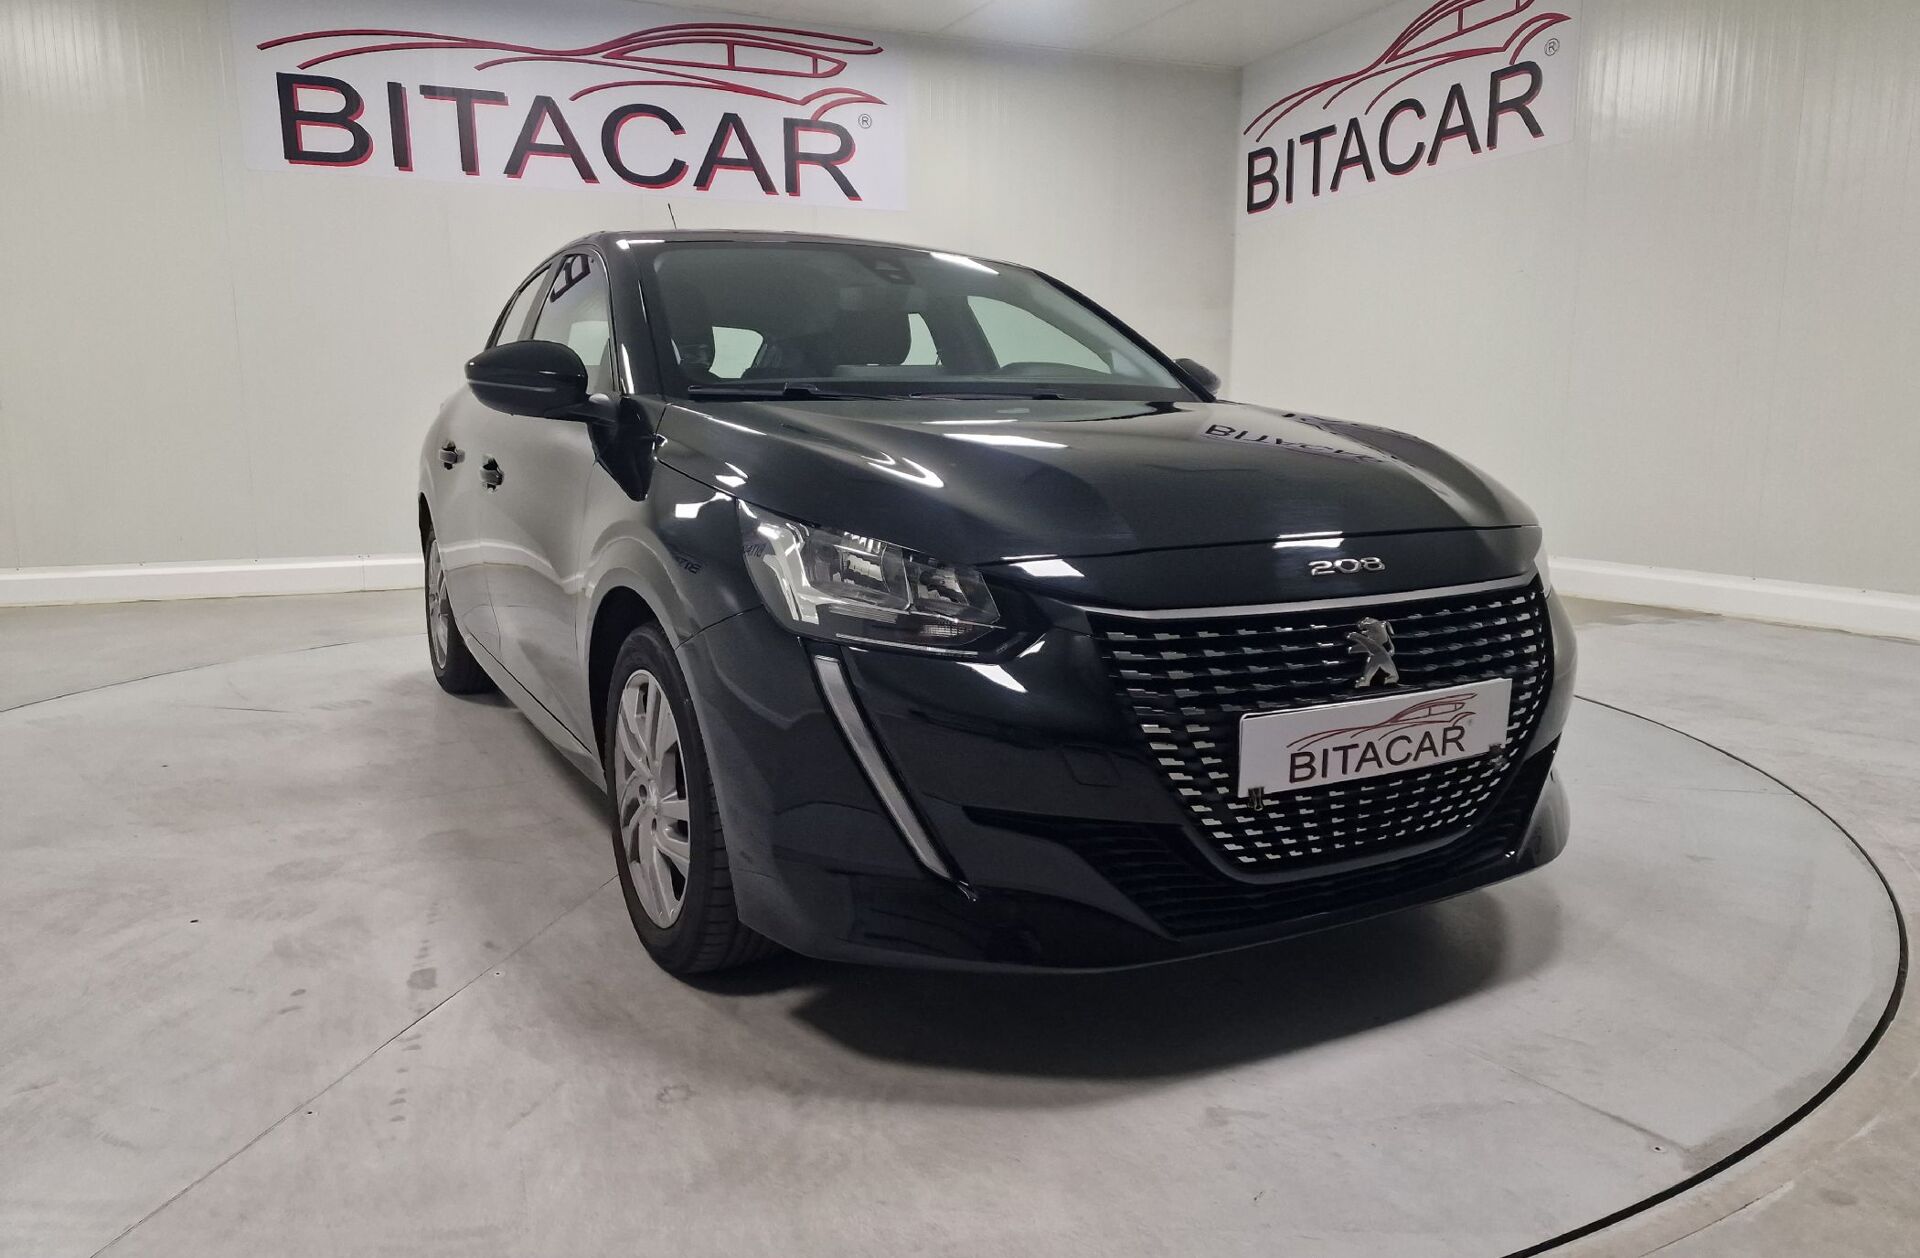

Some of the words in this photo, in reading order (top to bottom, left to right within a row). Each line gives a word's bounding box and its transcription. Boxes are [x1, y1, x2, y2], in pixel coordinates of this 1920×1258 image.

[276, 72, 862, 201] BITACAR
[1247, 61, 1544, 214] BITACAR
[1308, 557, 1385, 575] 208
[1289, 725, 1465, 783] BITACAR
